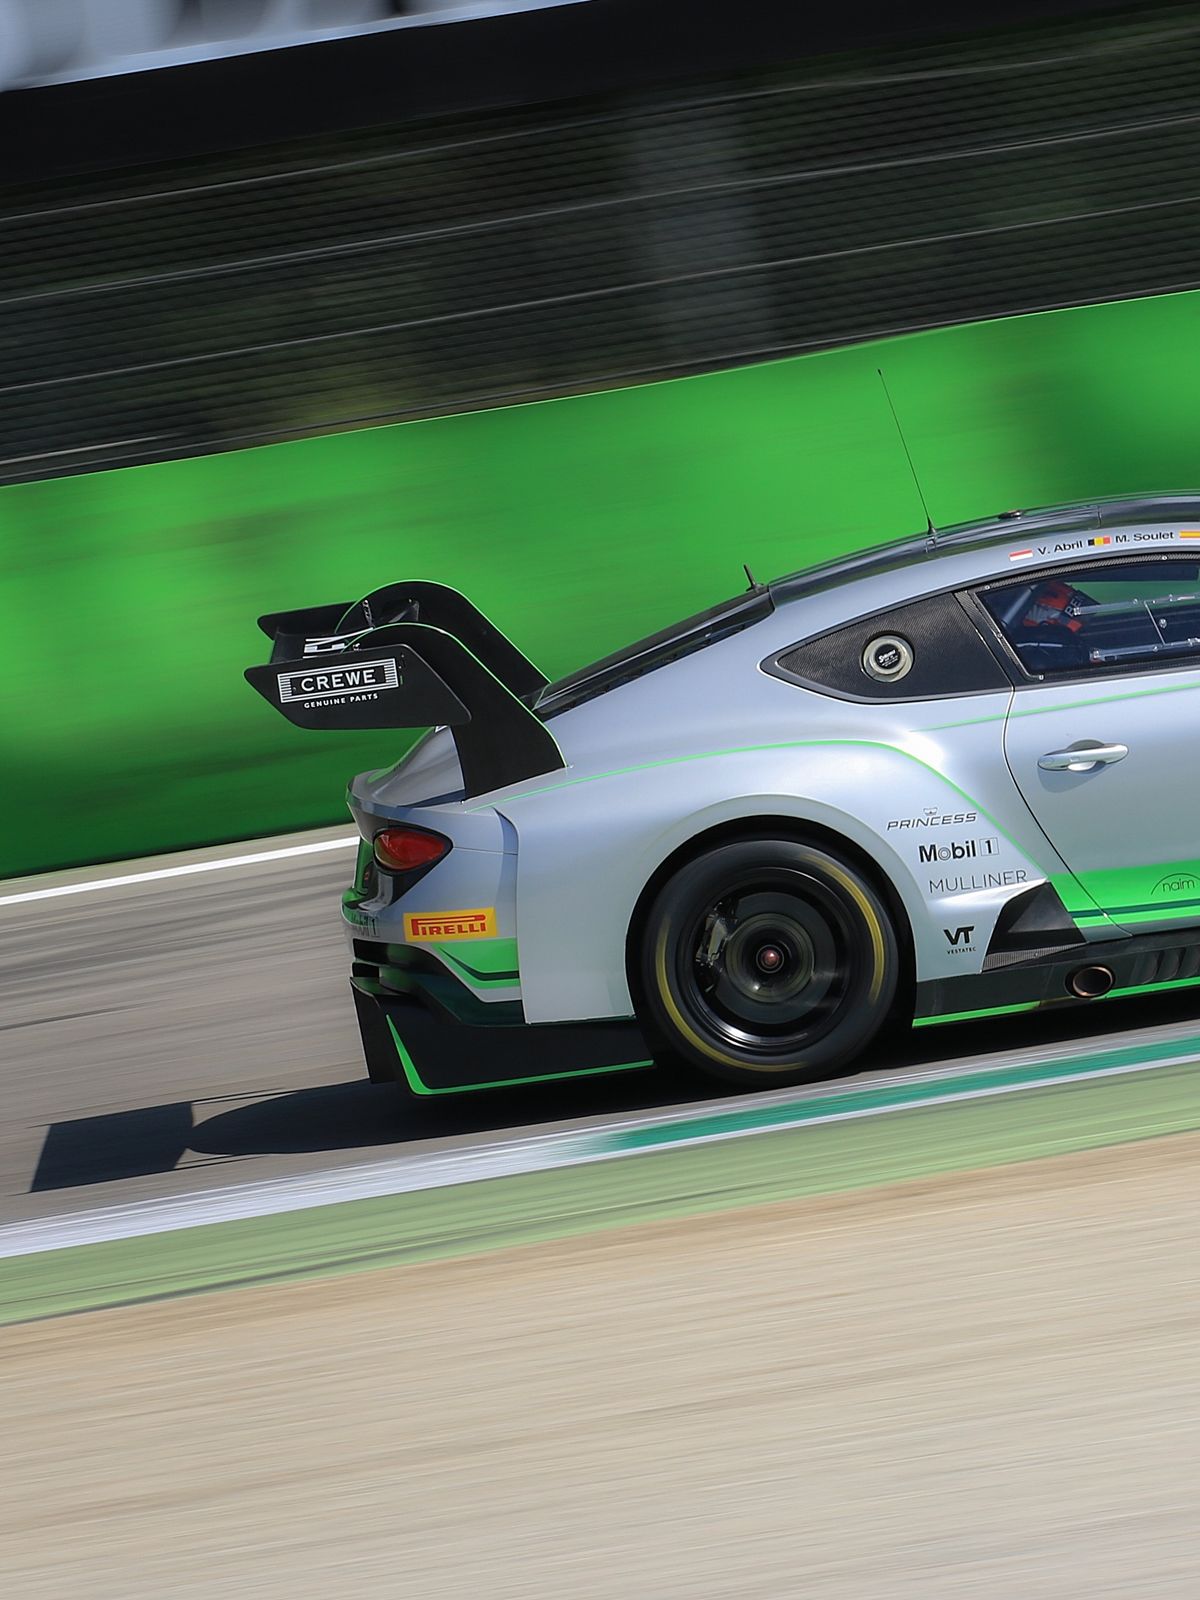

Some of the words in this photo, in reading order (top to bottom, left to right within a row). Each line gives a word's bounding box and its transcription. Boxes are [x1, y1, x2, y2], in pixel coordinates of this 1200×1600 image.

[1038, 547, 1050, 555] V.
[1053, 541, 1083, 553] Abril
[1115, 534, 1130, 543] M.
[1133, 531, 1174, 541] Soulet
[301, 669, 376, 692] CREWE
[304, 697, 346, 708] GENUINE
[350, 693, 378, 703] PARTS
[887, 812, 977, 831] PRINCESS
[918, 840, 976, 863] Mobil
[929, 869, 1027, 894] MULLINER
[411, 914, 487, 937] PIRELLI
